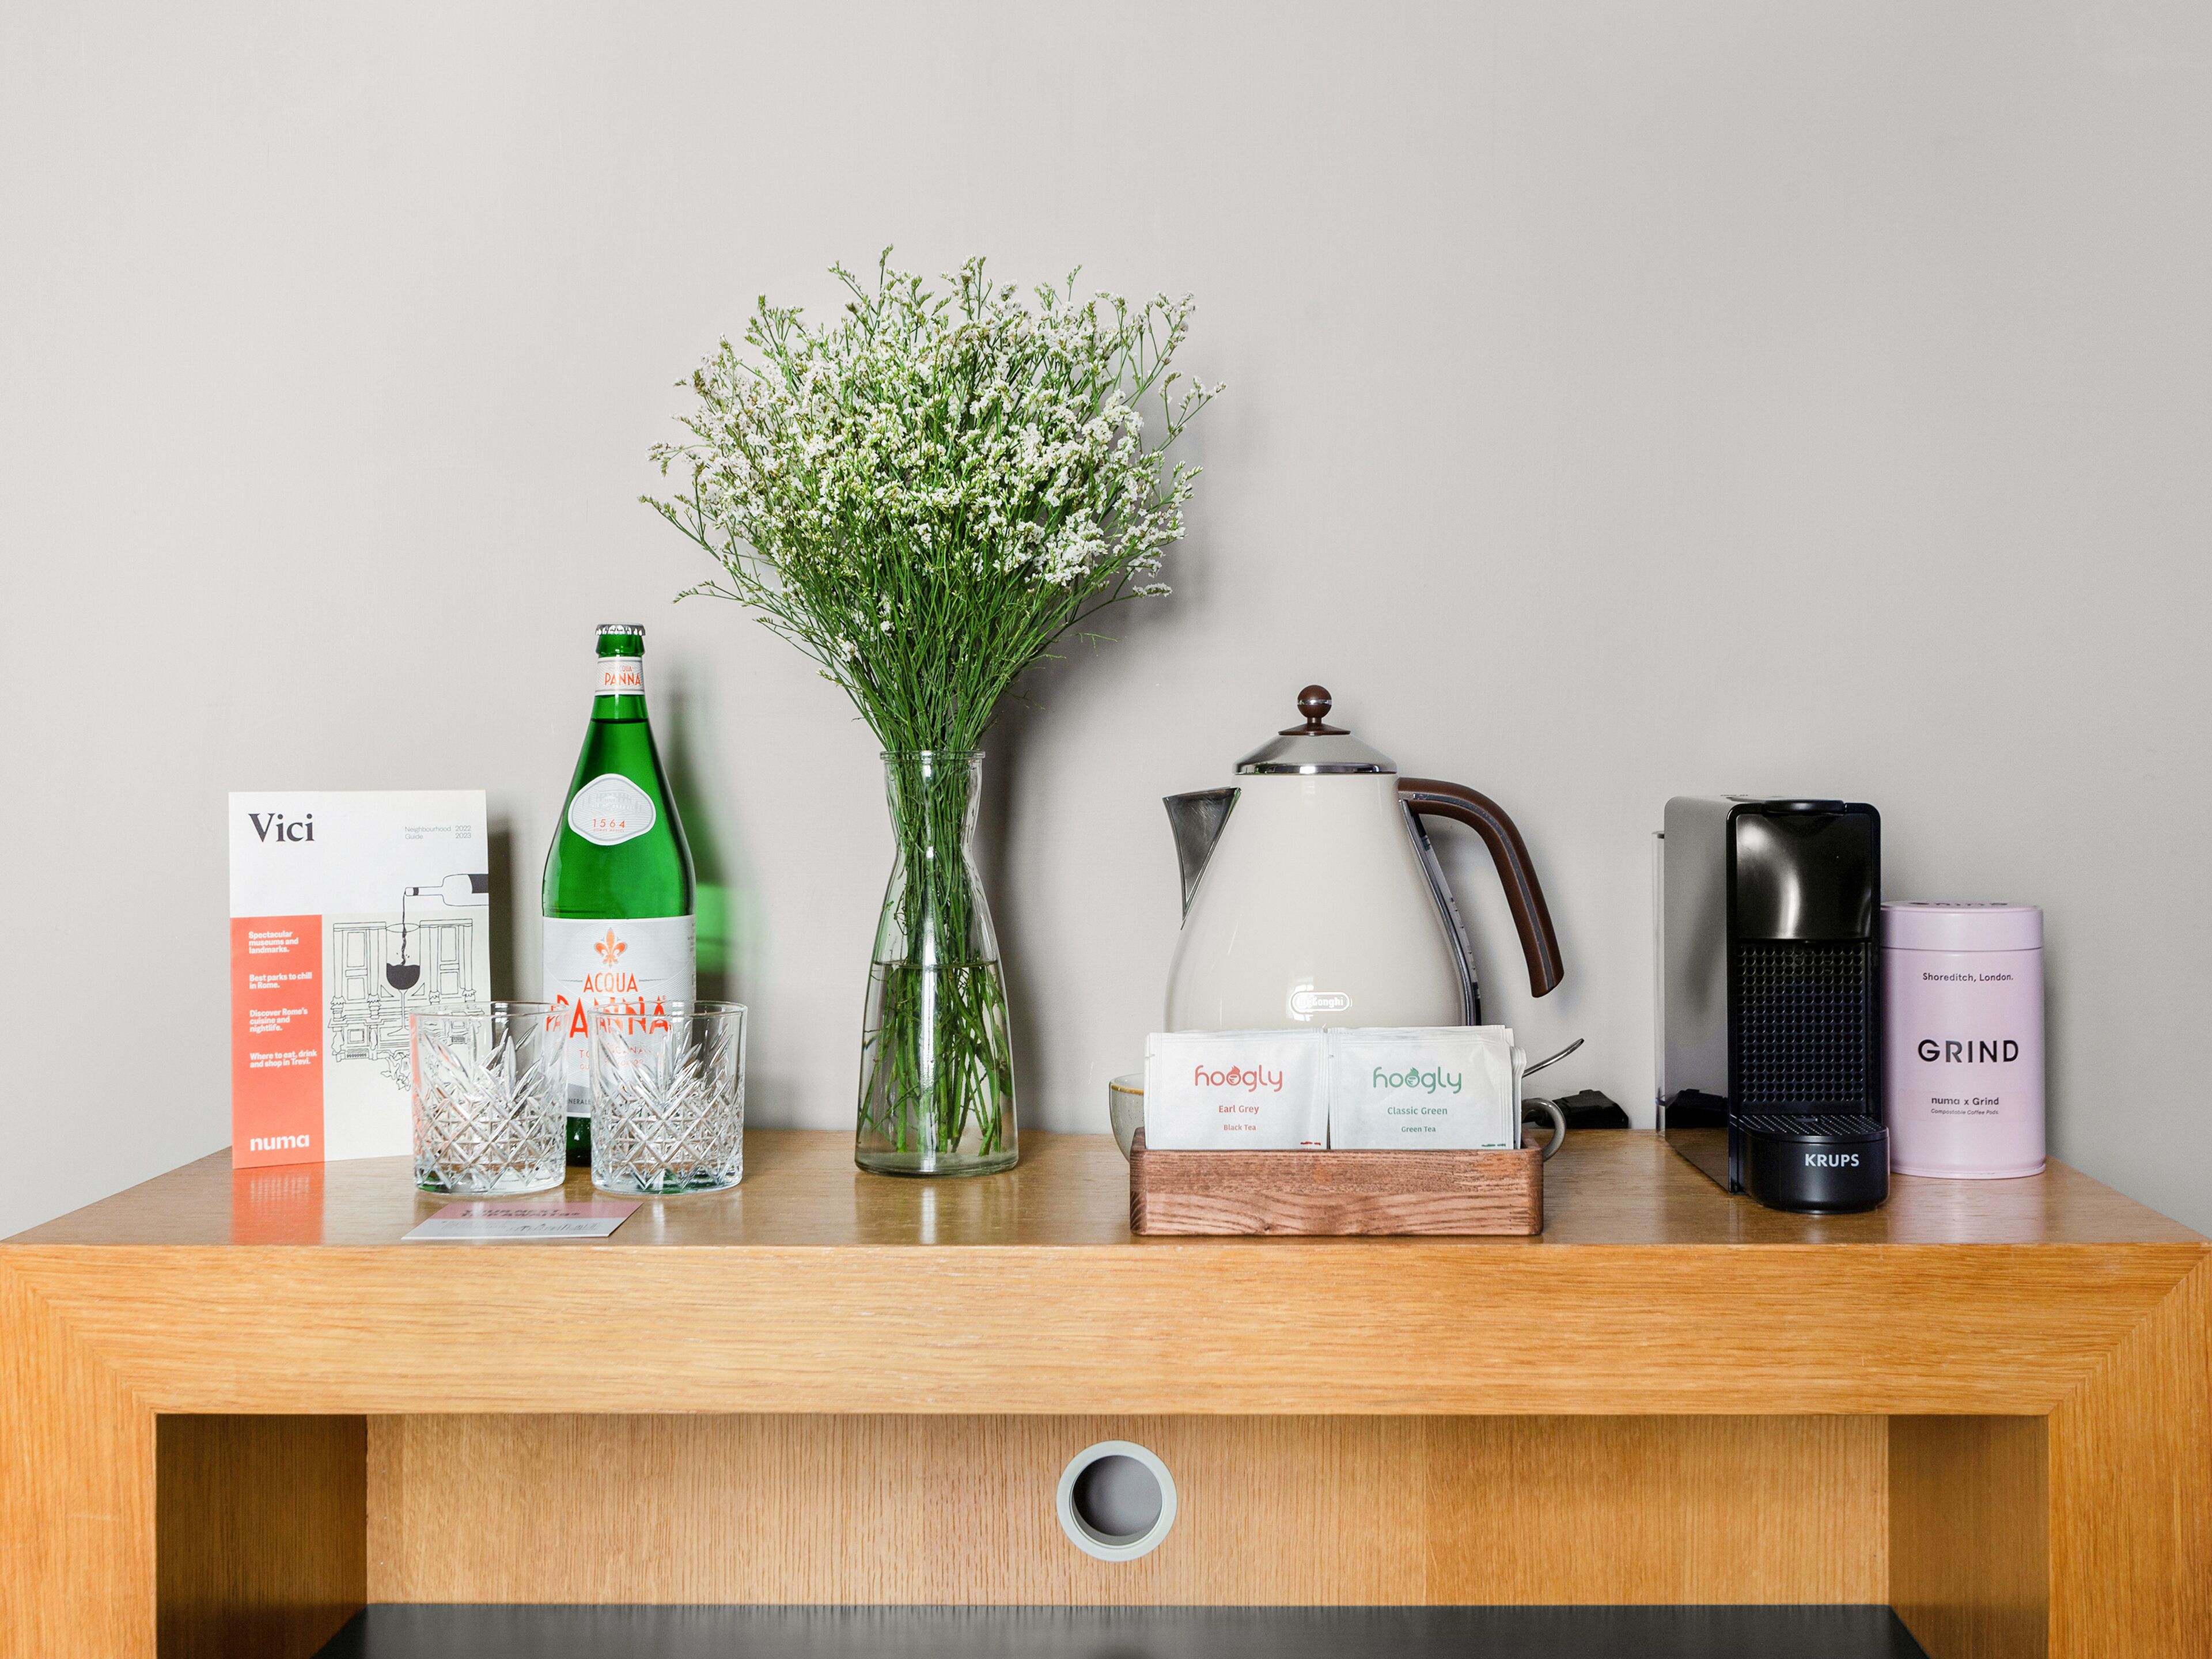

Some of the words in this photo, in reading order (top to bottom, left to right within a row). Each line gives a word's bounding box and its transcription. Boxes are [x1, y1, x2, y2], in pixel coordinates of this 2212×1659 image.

[604, 672, 641, 685] PANNA
[248, 813, 315, 843] Vici
[593, 819, 626, 828] 1564
[248, 930, 293, 940] Spectacular
[285, 937, 299, 945] and
[248, 945, 290, 954] landmarks.
[249, 974, 267, 982] Best
[267, 972, 287, 982] parks
[289, 972, 297, 980] to
[297, 971, 313, 980] chill
[1922, 972, 1976, 982] Shoreditch,
[1979, 973, 2014, 982] London.
[257, 981, 281, 989] Rome.
[583, 972, 638, 993] ACQUA
[249, 1009, 282, 1017] Discover
[282, 1007, 308, 1016] Rome's
[249, 1017, 276, 1025] cuisine
[276, 1015, 291, 1024] and
[249, 1024, 283, 1034] nightlife.
[249, 1052, 274, 1060] Where
[298, 1049, 317, 1058] drink
[1917, 1039, 2019, 1063] GRIND
[249, 1060, 264, 1068] and
[264, 1059, 283, 1068] shop
[283, 1058, 291, 1066] in
[291, 1057, 311, 1066] Trevi.
[1195, 1065, 1283, 1092] hoogly
[1373, 1066, 1462, 1096] hoogly
[1972, 1097, 1999, 1105] Grind
[1218, 1105, 1236, 1113] Earl
[1238, 1105, 1260, 1115] Grey
[1387, 1106, 1418, 1115] Classic
[1421, 1107, 1448, 1115] Green
[250, 1135, 309, 1151] numa
[1805, 1153, 1860, 1168] KRUPS
